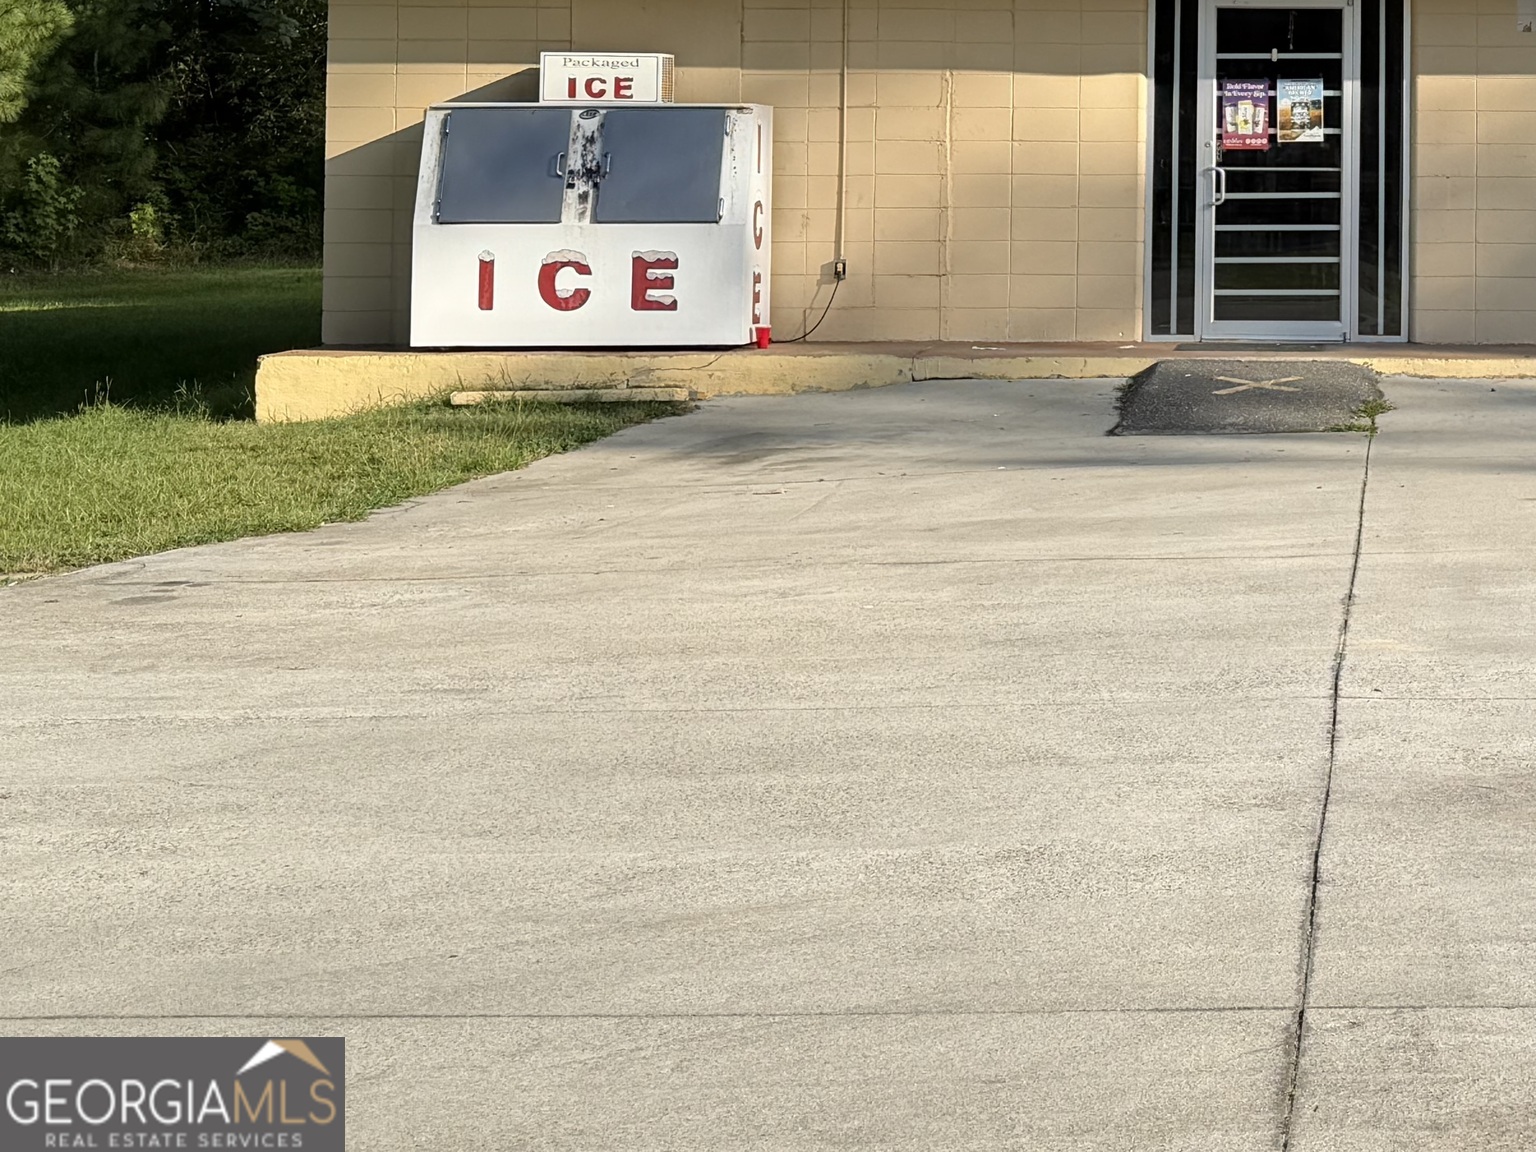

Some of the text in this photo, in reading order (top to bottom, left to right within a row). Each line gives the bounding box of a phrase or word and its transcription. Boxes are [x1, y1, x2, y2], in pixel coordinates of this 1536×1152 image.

[563, 57, 639, 69] Packaged
[568, 74, 634, 99] ICE
[478, 249, 679, 311] ICE
